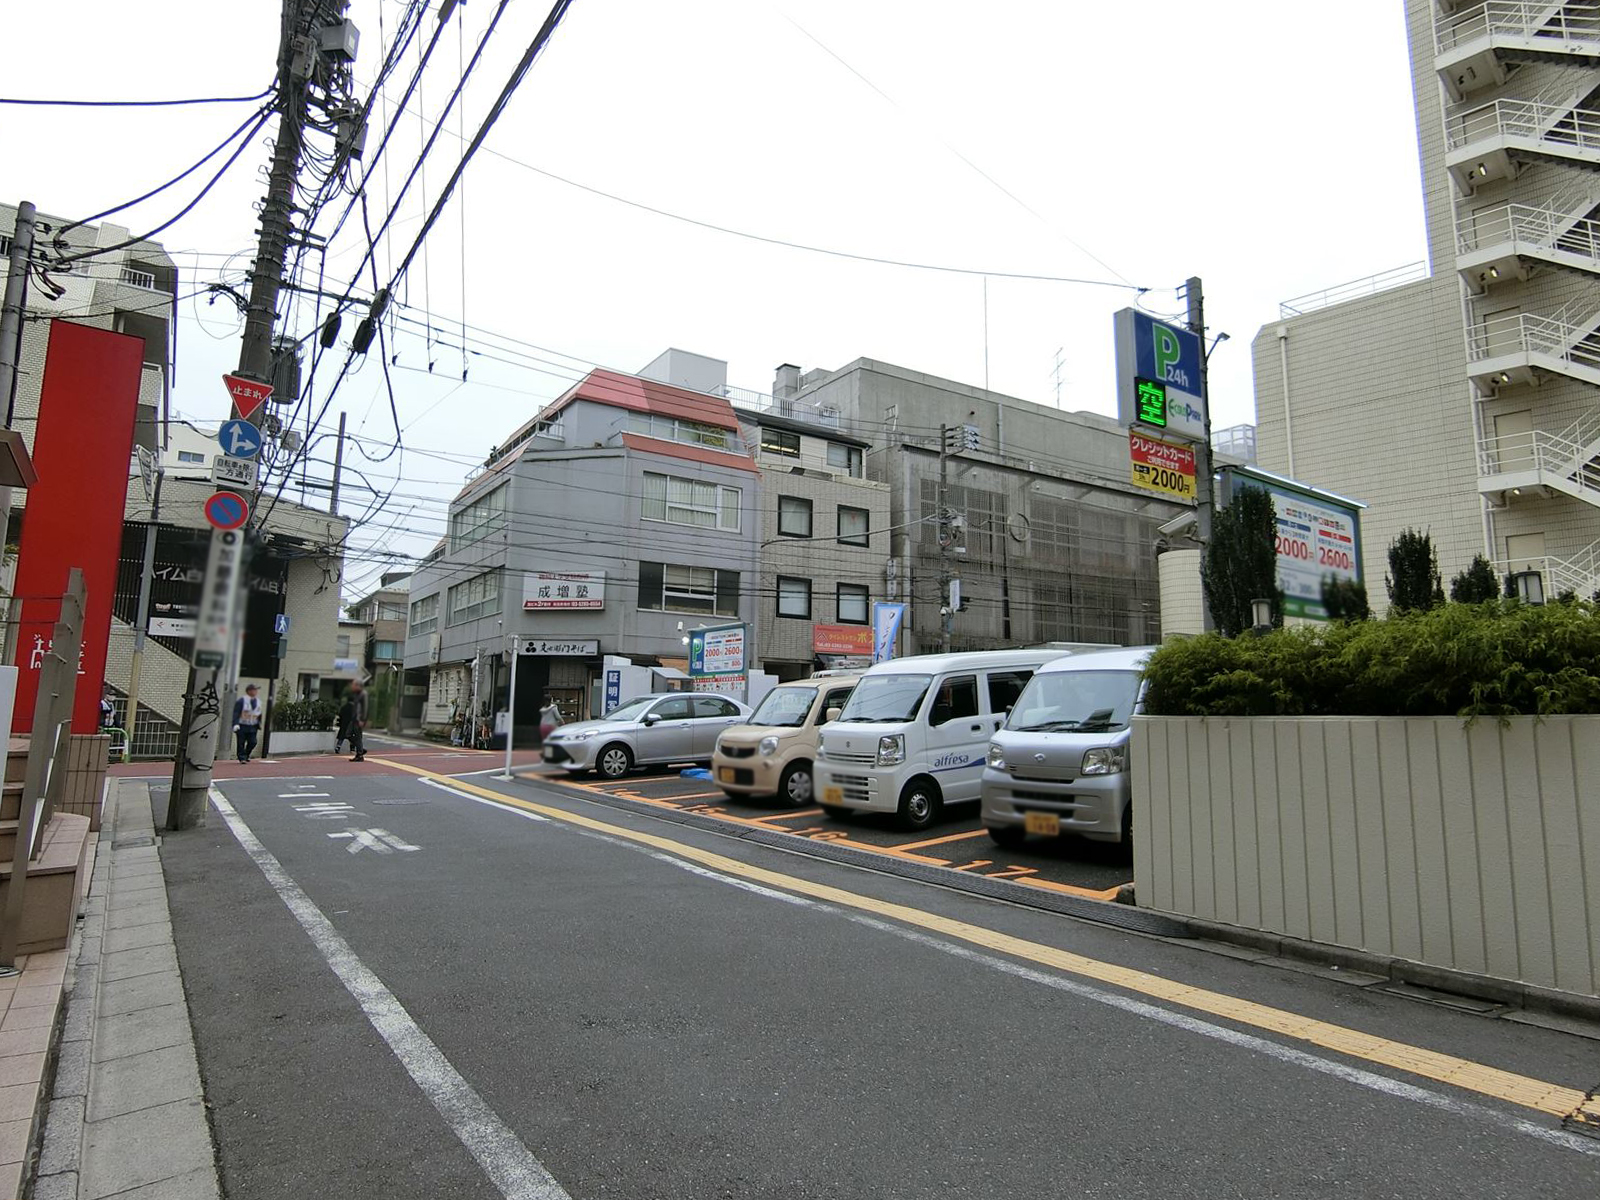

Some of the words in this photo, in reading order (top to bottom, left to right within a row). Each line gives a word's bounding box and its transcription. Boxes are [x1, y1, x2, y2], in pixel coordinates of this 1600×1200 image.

[1152, 321, 1181, 382] P
[1167, 365, 1189, 388] 24h
[233, 385, 263, 399] 止まれ
[1138, 382, 1165, 426] 空
[1131, 436, 1192, 465] クレジットカード
[216, 467, 254, 481] 一方通行
[217, 458, 255, 473] 自転車を除く
[1151, 467, 1190, 493] 2000円
[538, 584, 589, 599] 成増塾
[934, 751, 970, 768] alfresa
